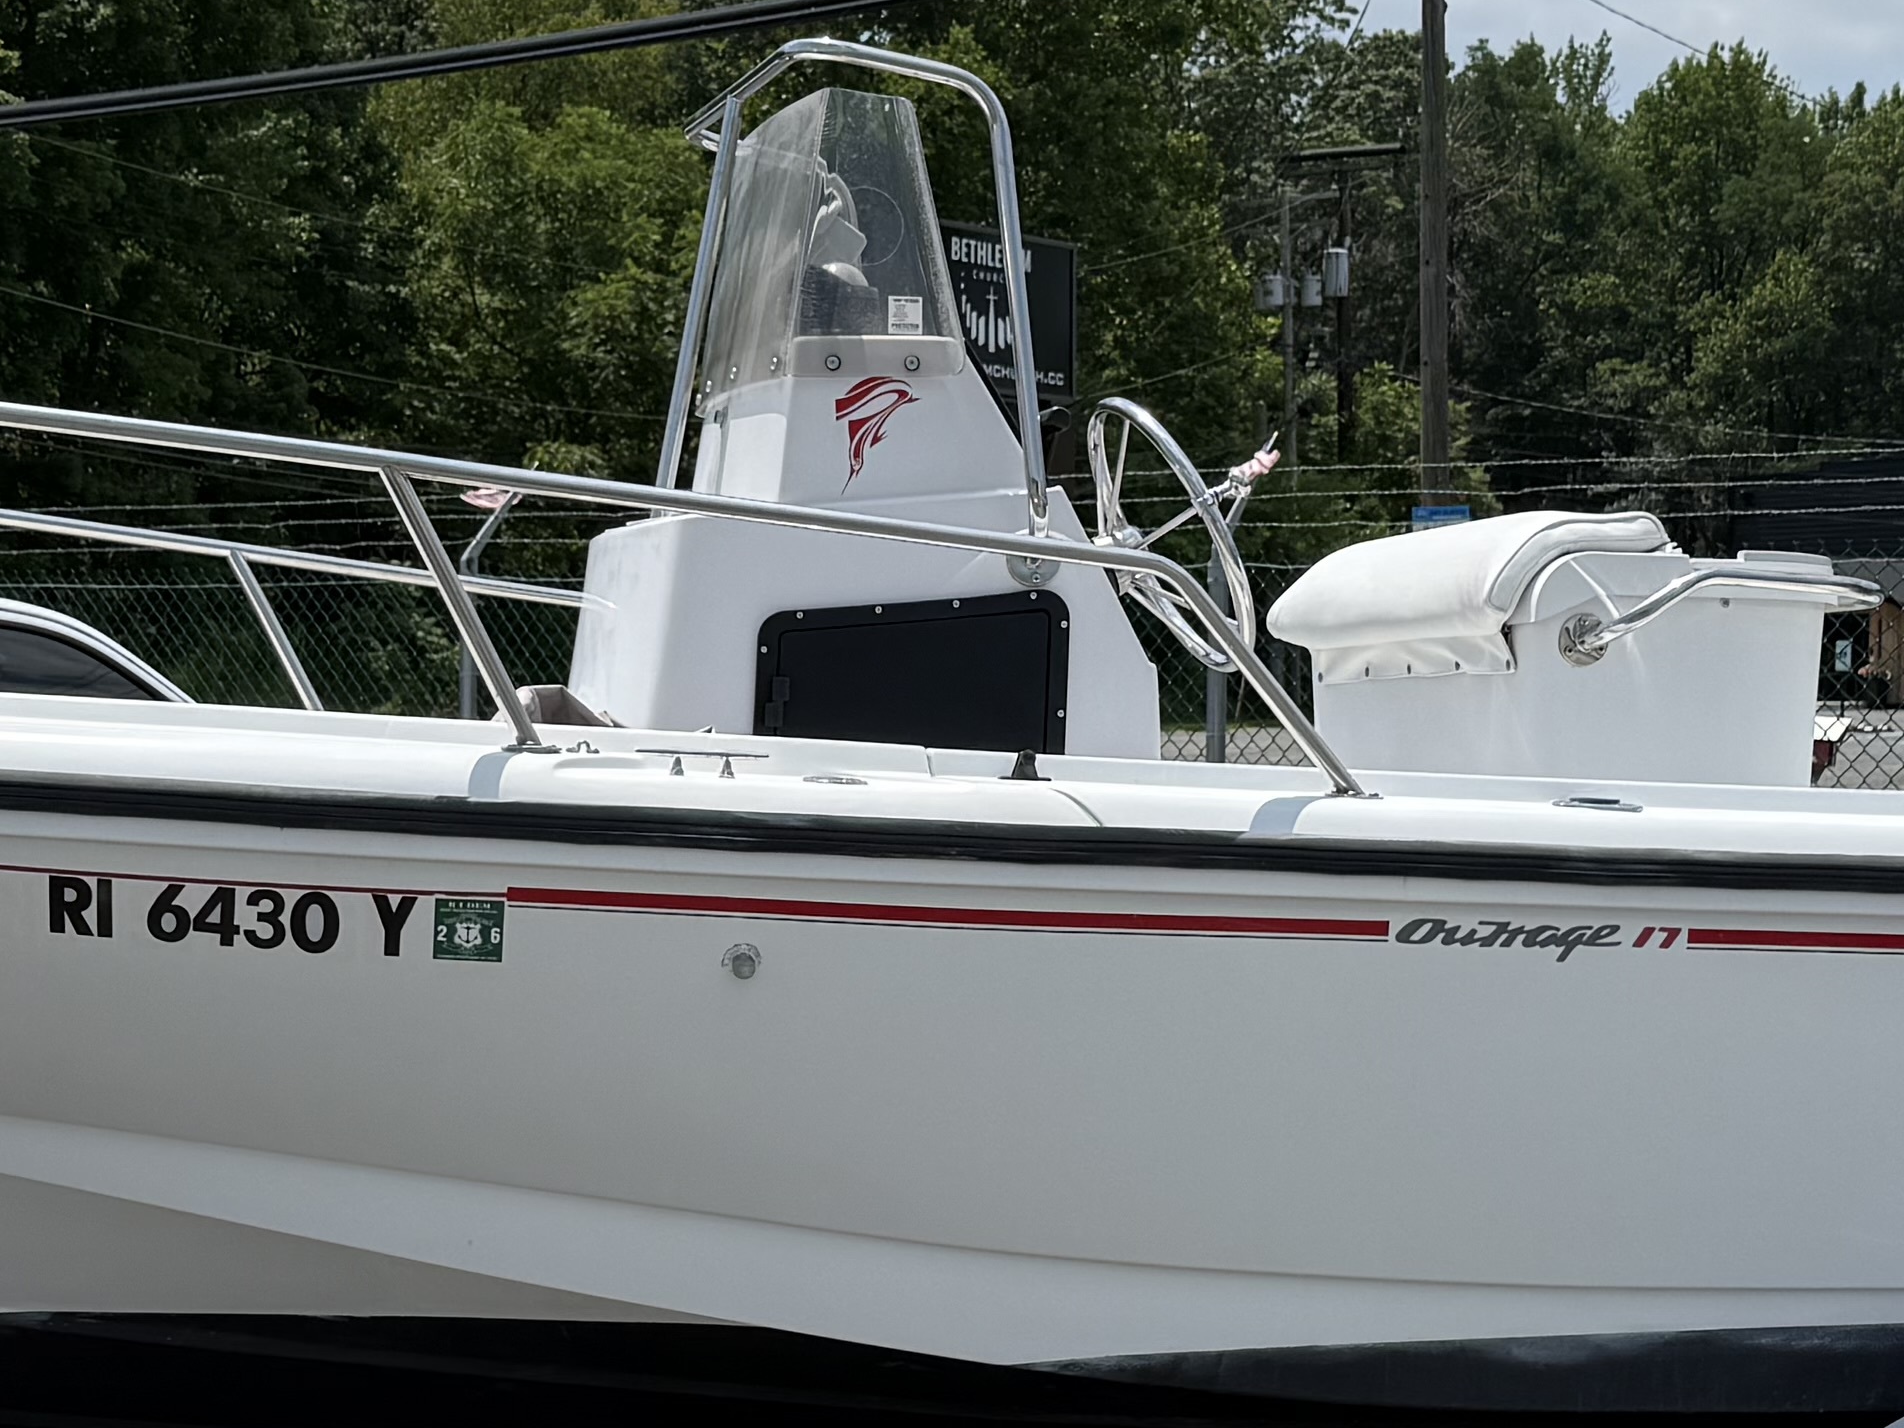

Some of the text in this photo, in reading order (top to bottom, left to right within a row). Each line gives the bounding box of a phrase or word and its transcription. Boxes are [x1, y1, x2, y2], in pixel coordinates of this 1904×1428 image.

[951, 236, 1032, 273] BETHLEM
[48, 874, 419, 957] RI 6430 Y
[1395, 917, 1682, 963] Outrage 17
